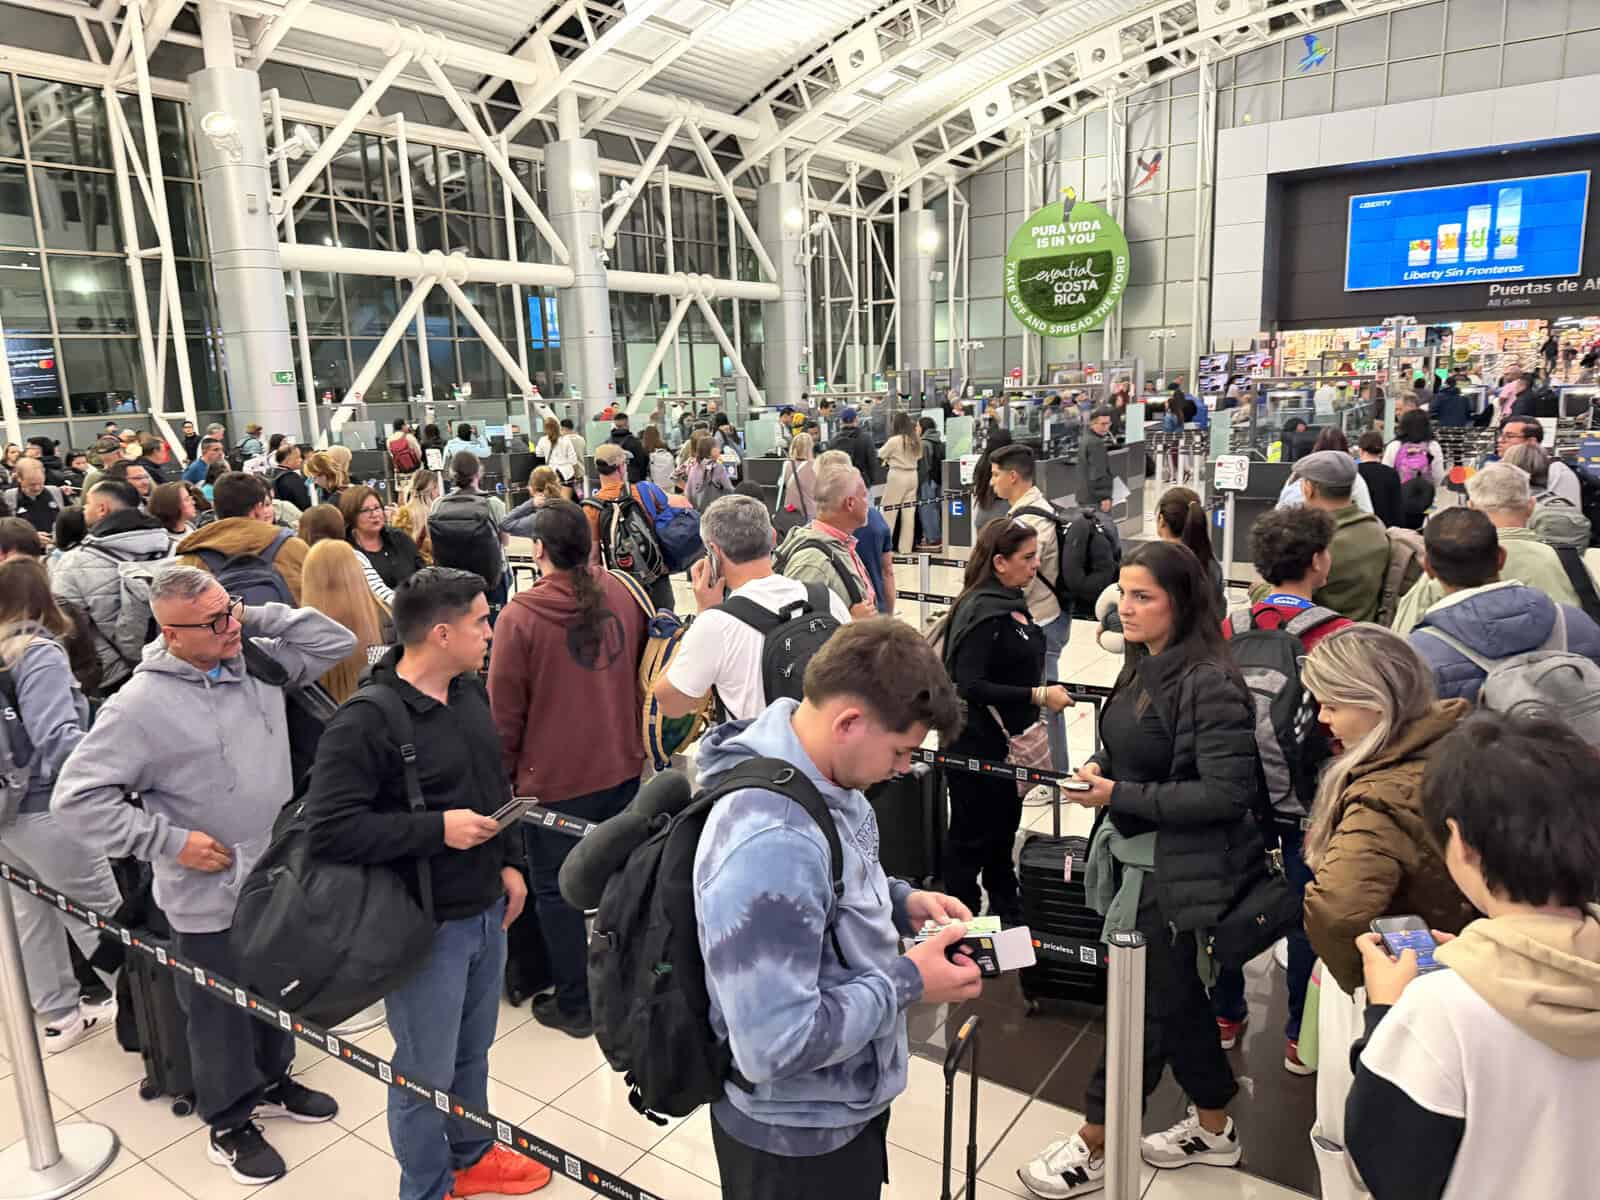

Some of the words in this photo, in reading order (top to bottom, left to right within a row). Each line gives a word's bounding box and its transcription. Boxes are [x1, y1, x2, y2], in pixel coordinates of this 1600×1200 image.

[1031, 224, 1066, 238] PURA
[1069, 220, 1102, 233] VIDA
[1037, 237, 1049, 249] IS
[1051, 235, 1065, 247] IN
[1067, 232, 1096, 245] YOU
[1007, 261, 1017, 292] TAKE
[1021, 257, 1105, 284] essential
[1111, 255, 1126, 294] WORD
[1403, 270, 1443, 281] Liberty
[1444, 267, 1464, 278] Sin
[1465, 264, 1525, 276] Fronteras
[1054, 279, 1099, 293] COSTA
[1488, 281, 1552, 296] Puertas
[1556, 279, 1578, 293] de
[1010, 295, 1026, 315] OFF
[1054, 293, 1086, 306] RICA
[1094, 298, 1114, 318] THE
[1025, 315, 1047, 331] AND
[1049, 316, 1093, 334] SPREAD
[952, 501, 963, 515] E
[1043, 942, 1074, 955] priceless
[464, 1110, 493, 1129] priceless
[600, 1179, 634, 1200] priceless
